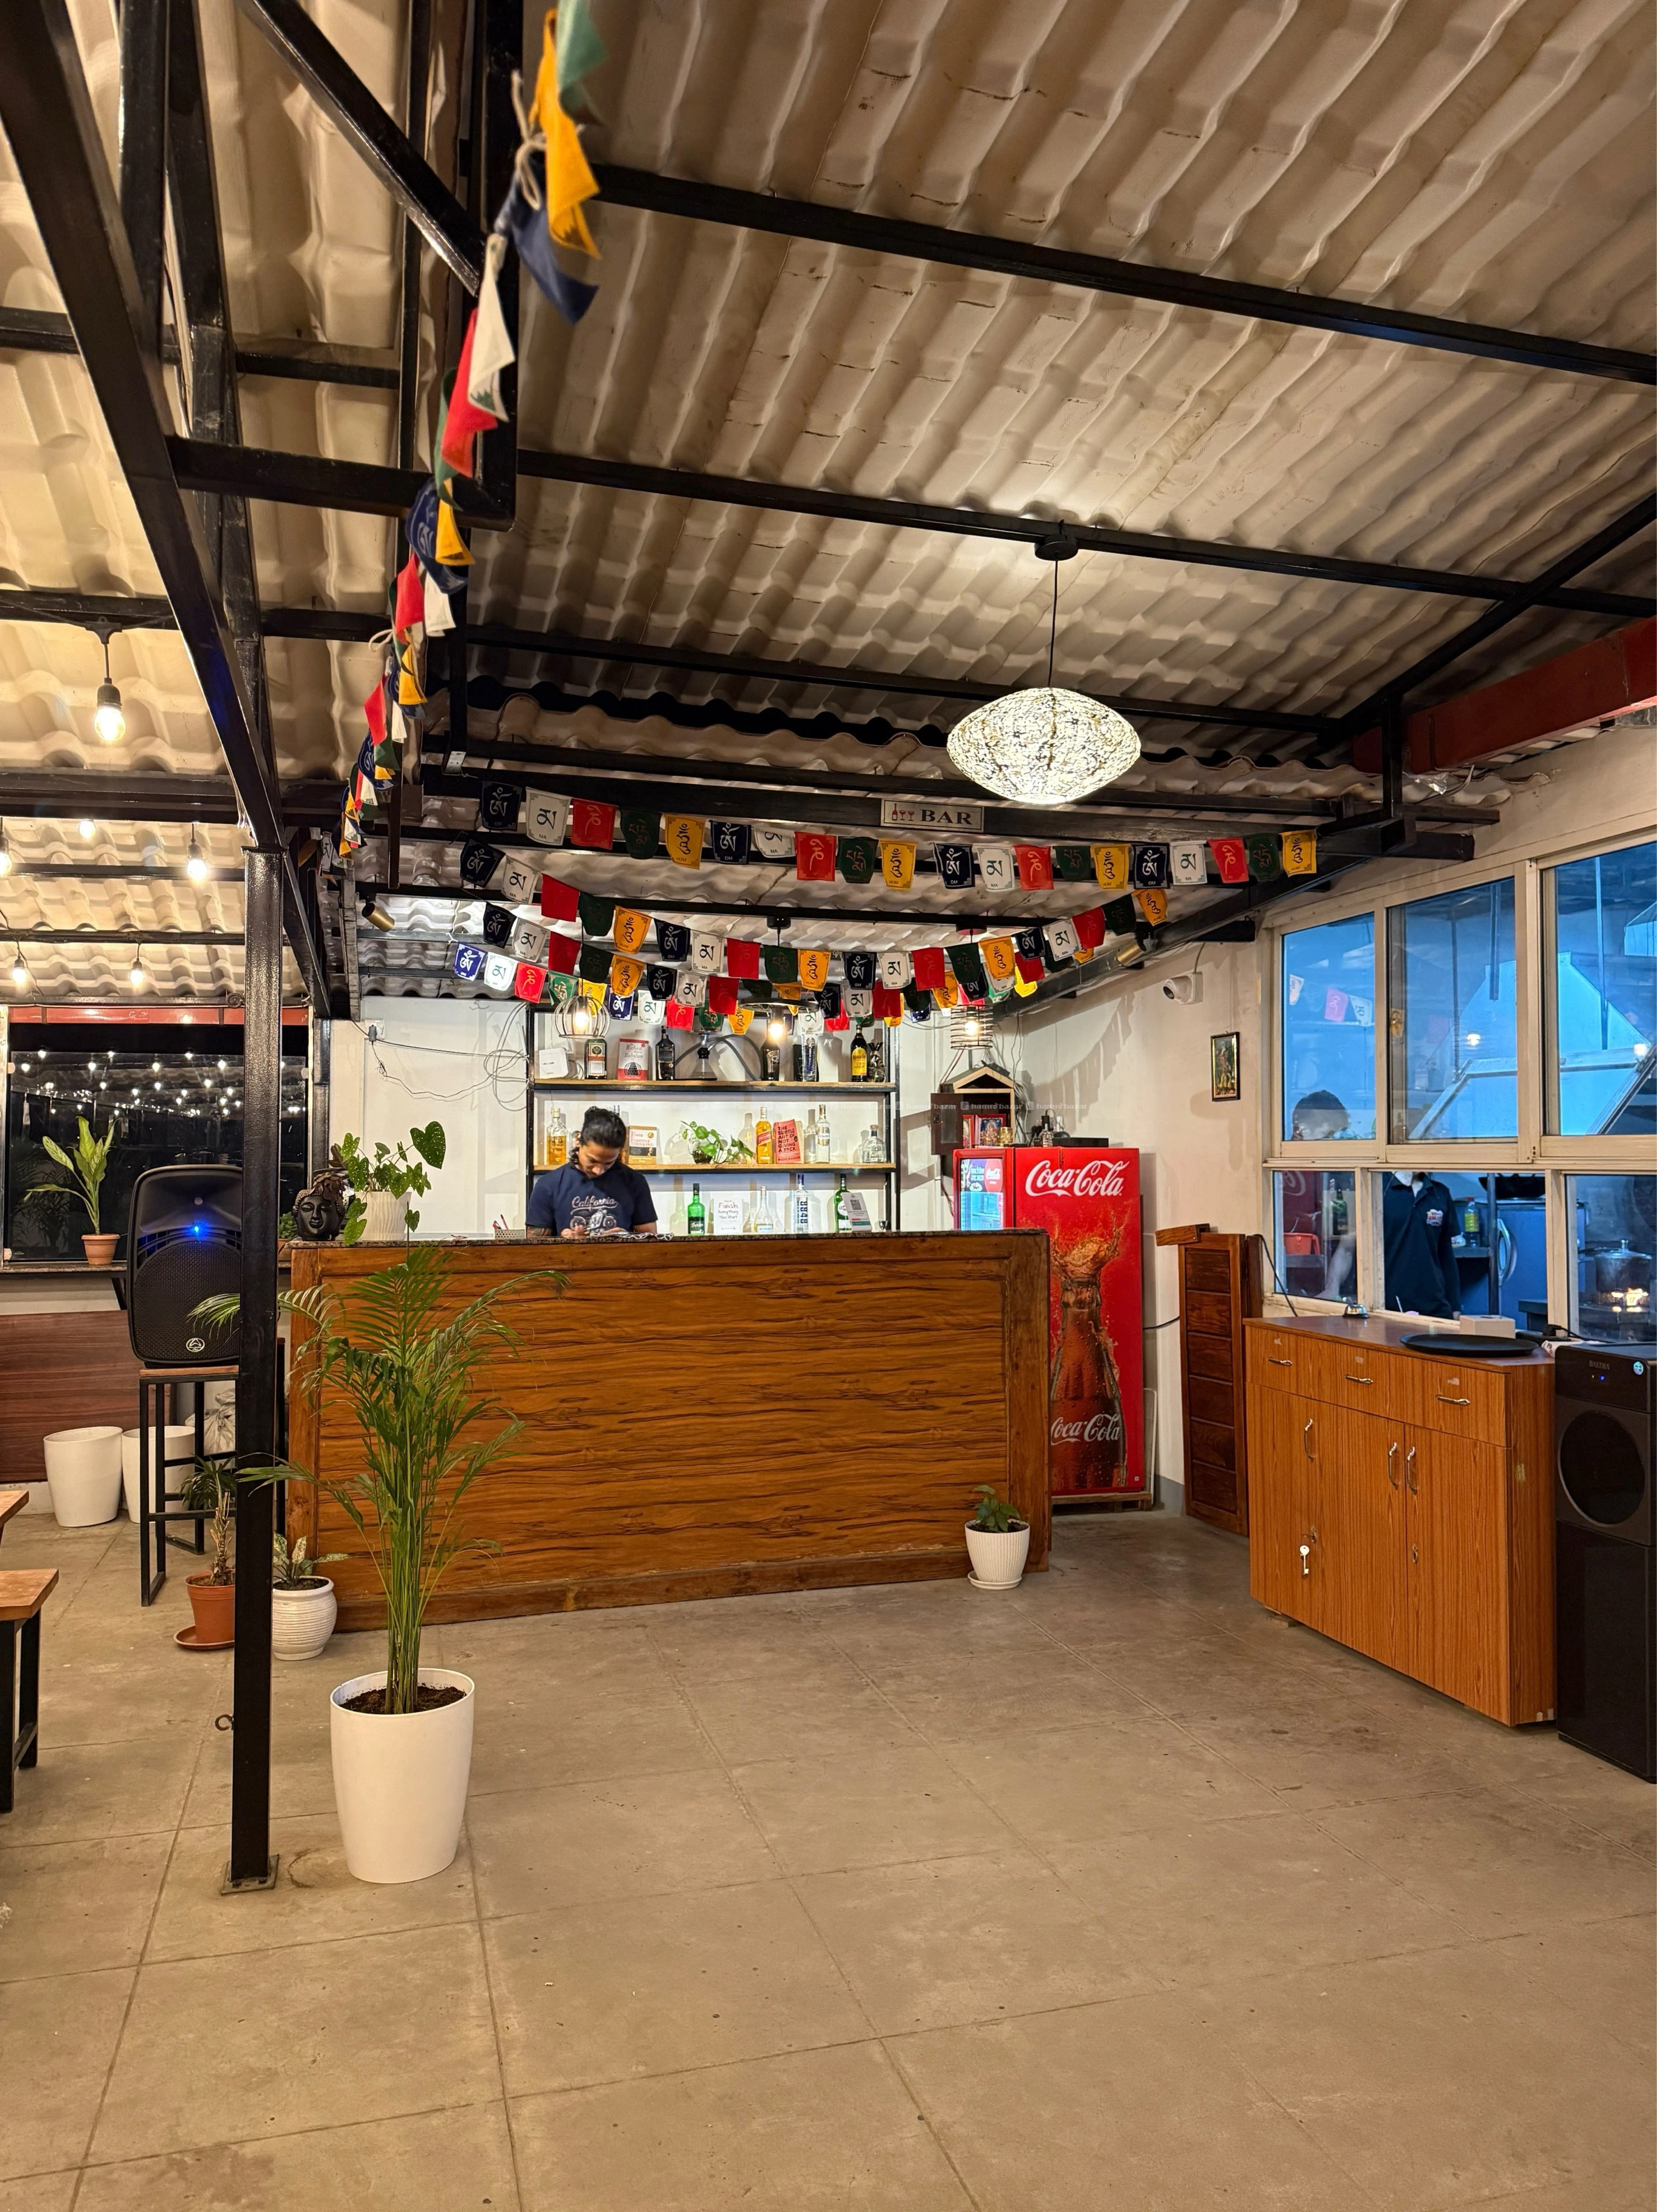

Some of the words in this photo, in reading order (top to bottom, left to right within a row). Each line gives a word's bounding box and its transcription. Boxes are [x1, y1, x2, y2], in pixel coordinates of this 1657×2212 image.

[921, 809, 973, 825] BAR
[1025, 1160, 1129, 1197] Coca-Cola
[572, 1196, 617, 1210] California
[800, 1201, 808, 1224] 8848
[1589, 1360, 1610, 1370] BALTRA
